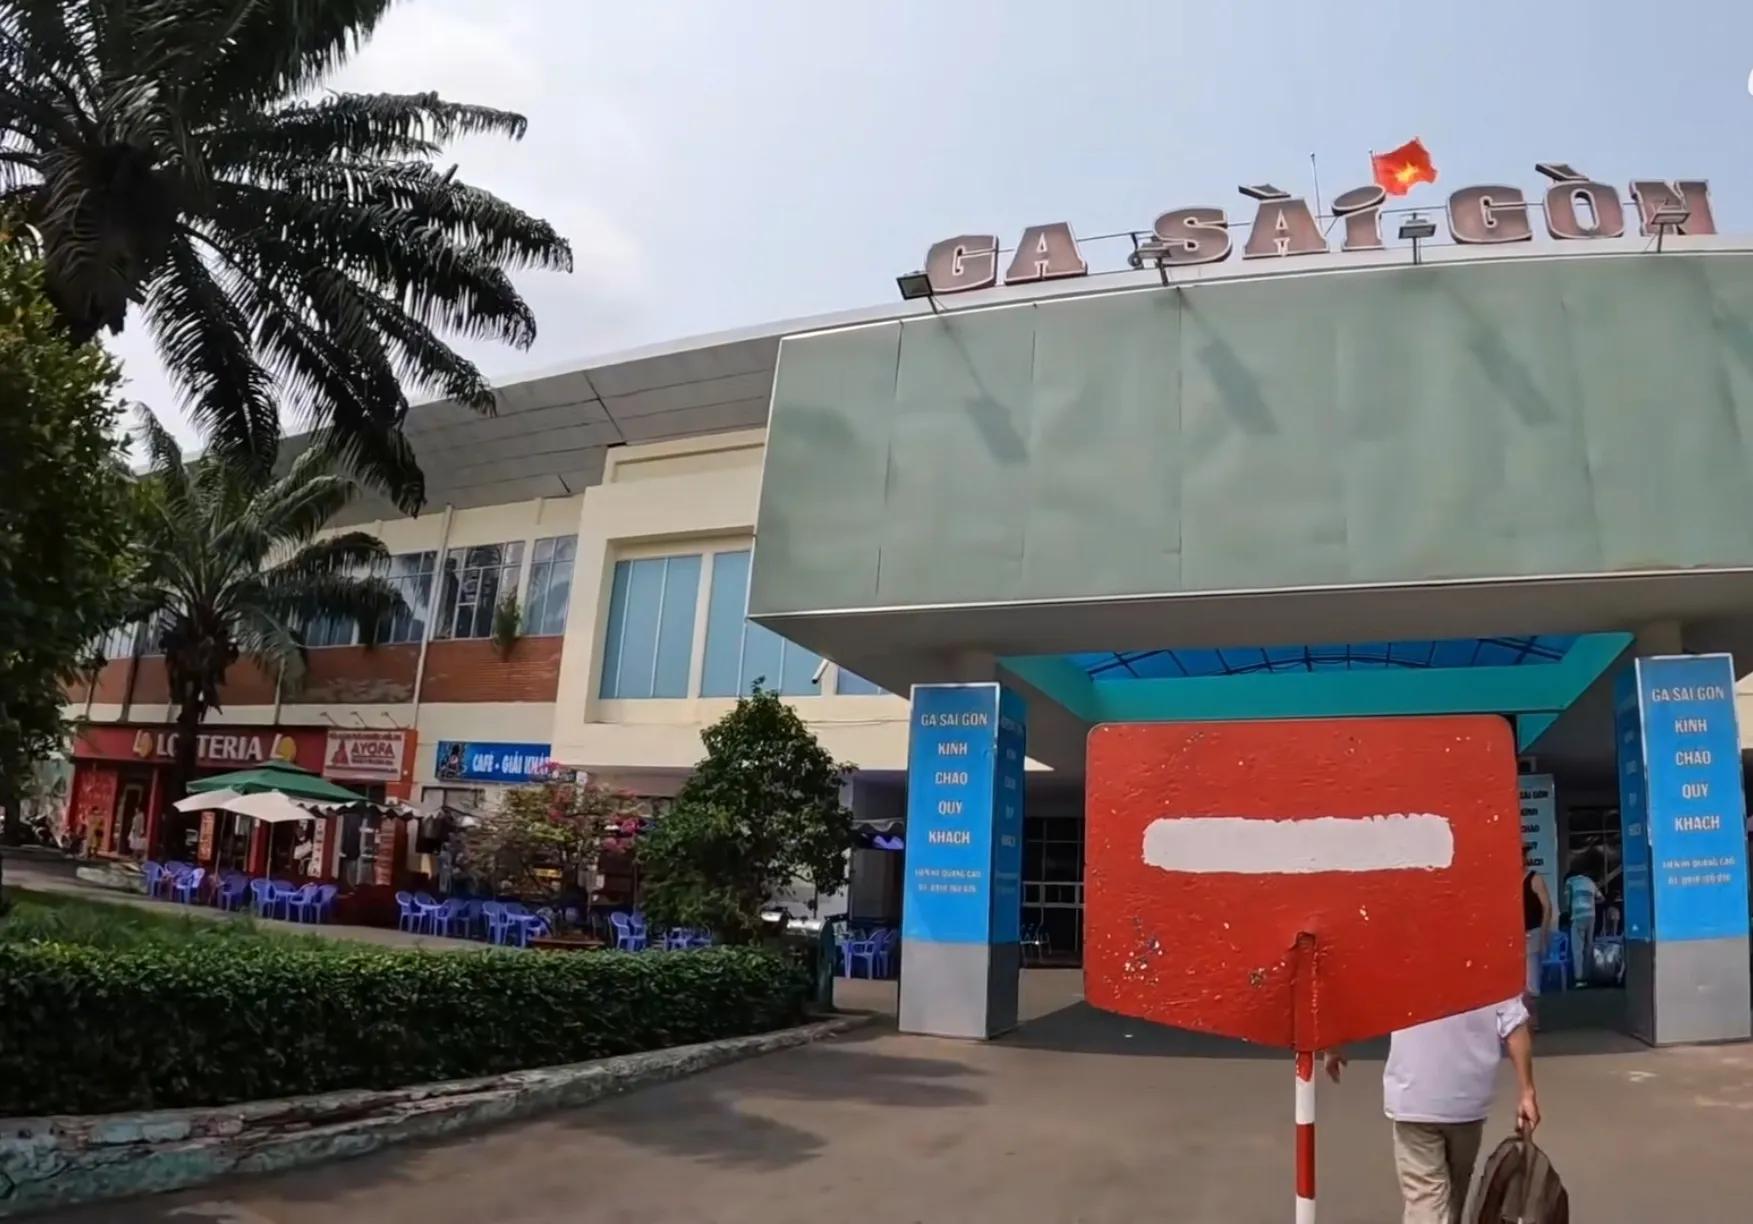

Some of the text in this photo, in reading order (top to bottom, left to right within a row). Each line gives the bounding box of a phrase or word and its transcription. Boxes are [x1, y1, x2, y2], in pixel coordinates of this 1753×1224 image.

[924, 220, 1088, 293] GA
[1446, 162, 1718, 244] GÒN
[1651, 688, 1671, 702] GA
[921, 713, 937, 727] GA
[156, 733, 264, 761] LOTERIA
